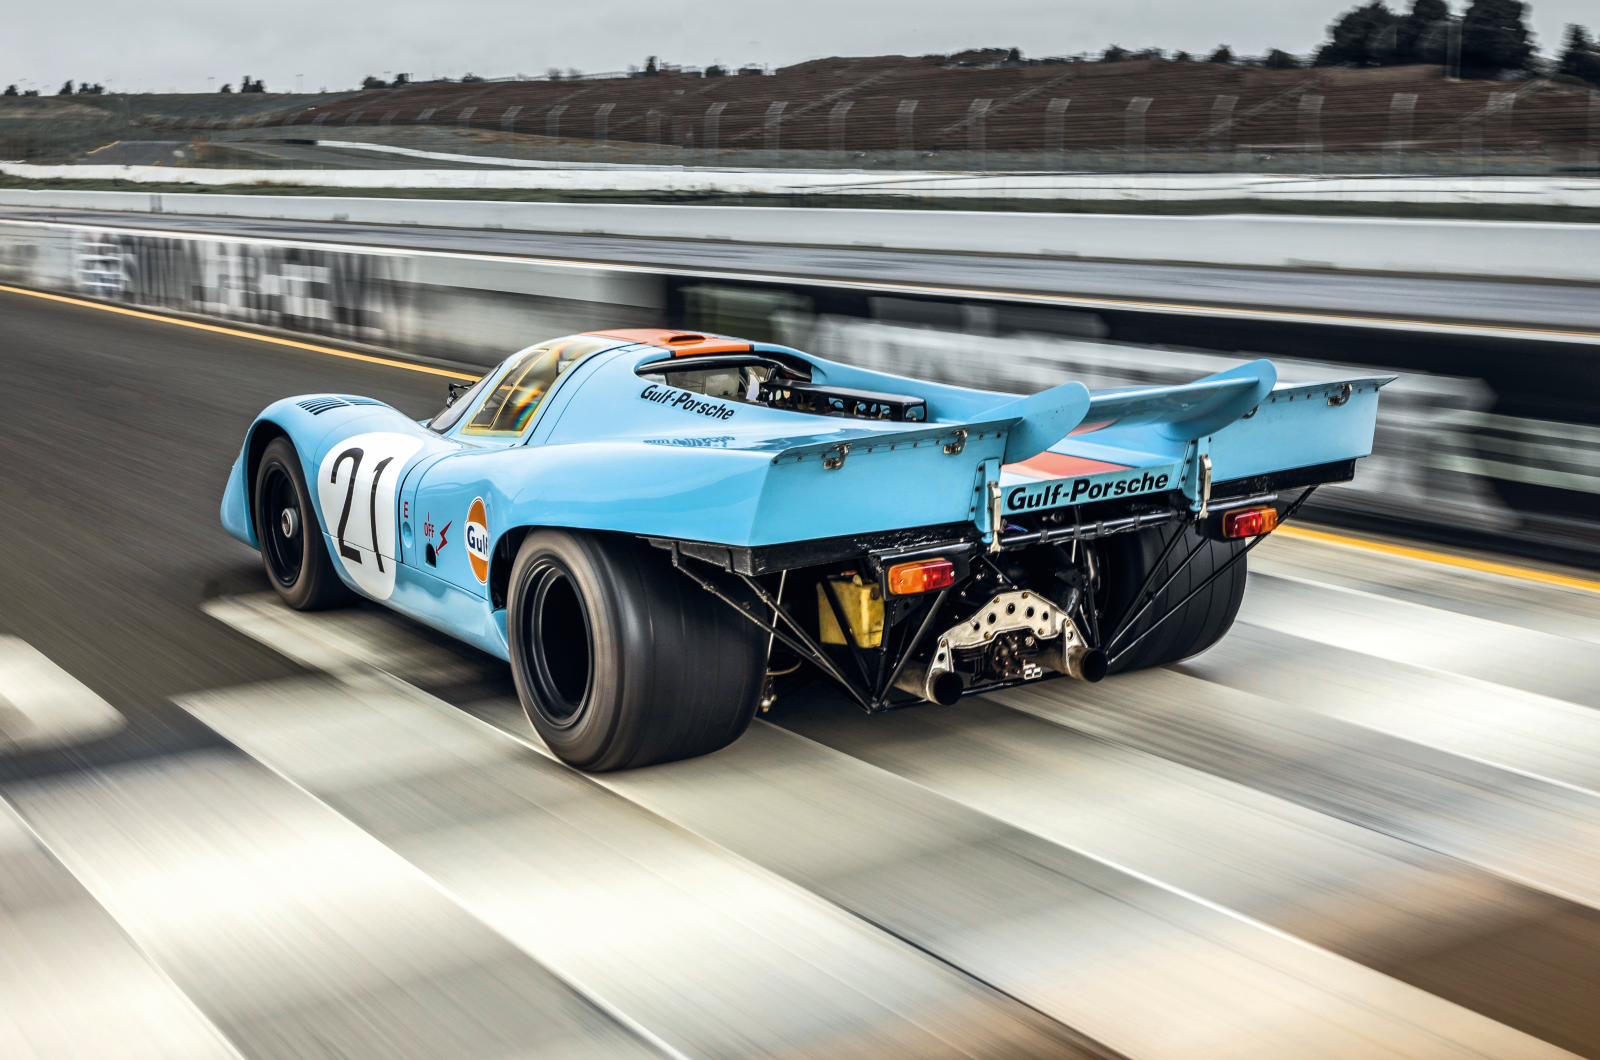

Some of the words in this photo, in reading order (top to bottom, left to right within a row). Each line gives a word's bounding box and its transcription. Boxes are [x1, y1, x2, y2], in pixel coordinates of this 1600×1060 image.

[640, 384, 735, 420] Gulf-Porsche
[1007, 471, 1169, 511] Gulf-Porsche
[330, 447, 394, 574] 21
[403, 501, 409, 519] E
[423, 522, 435, 538] OFF
